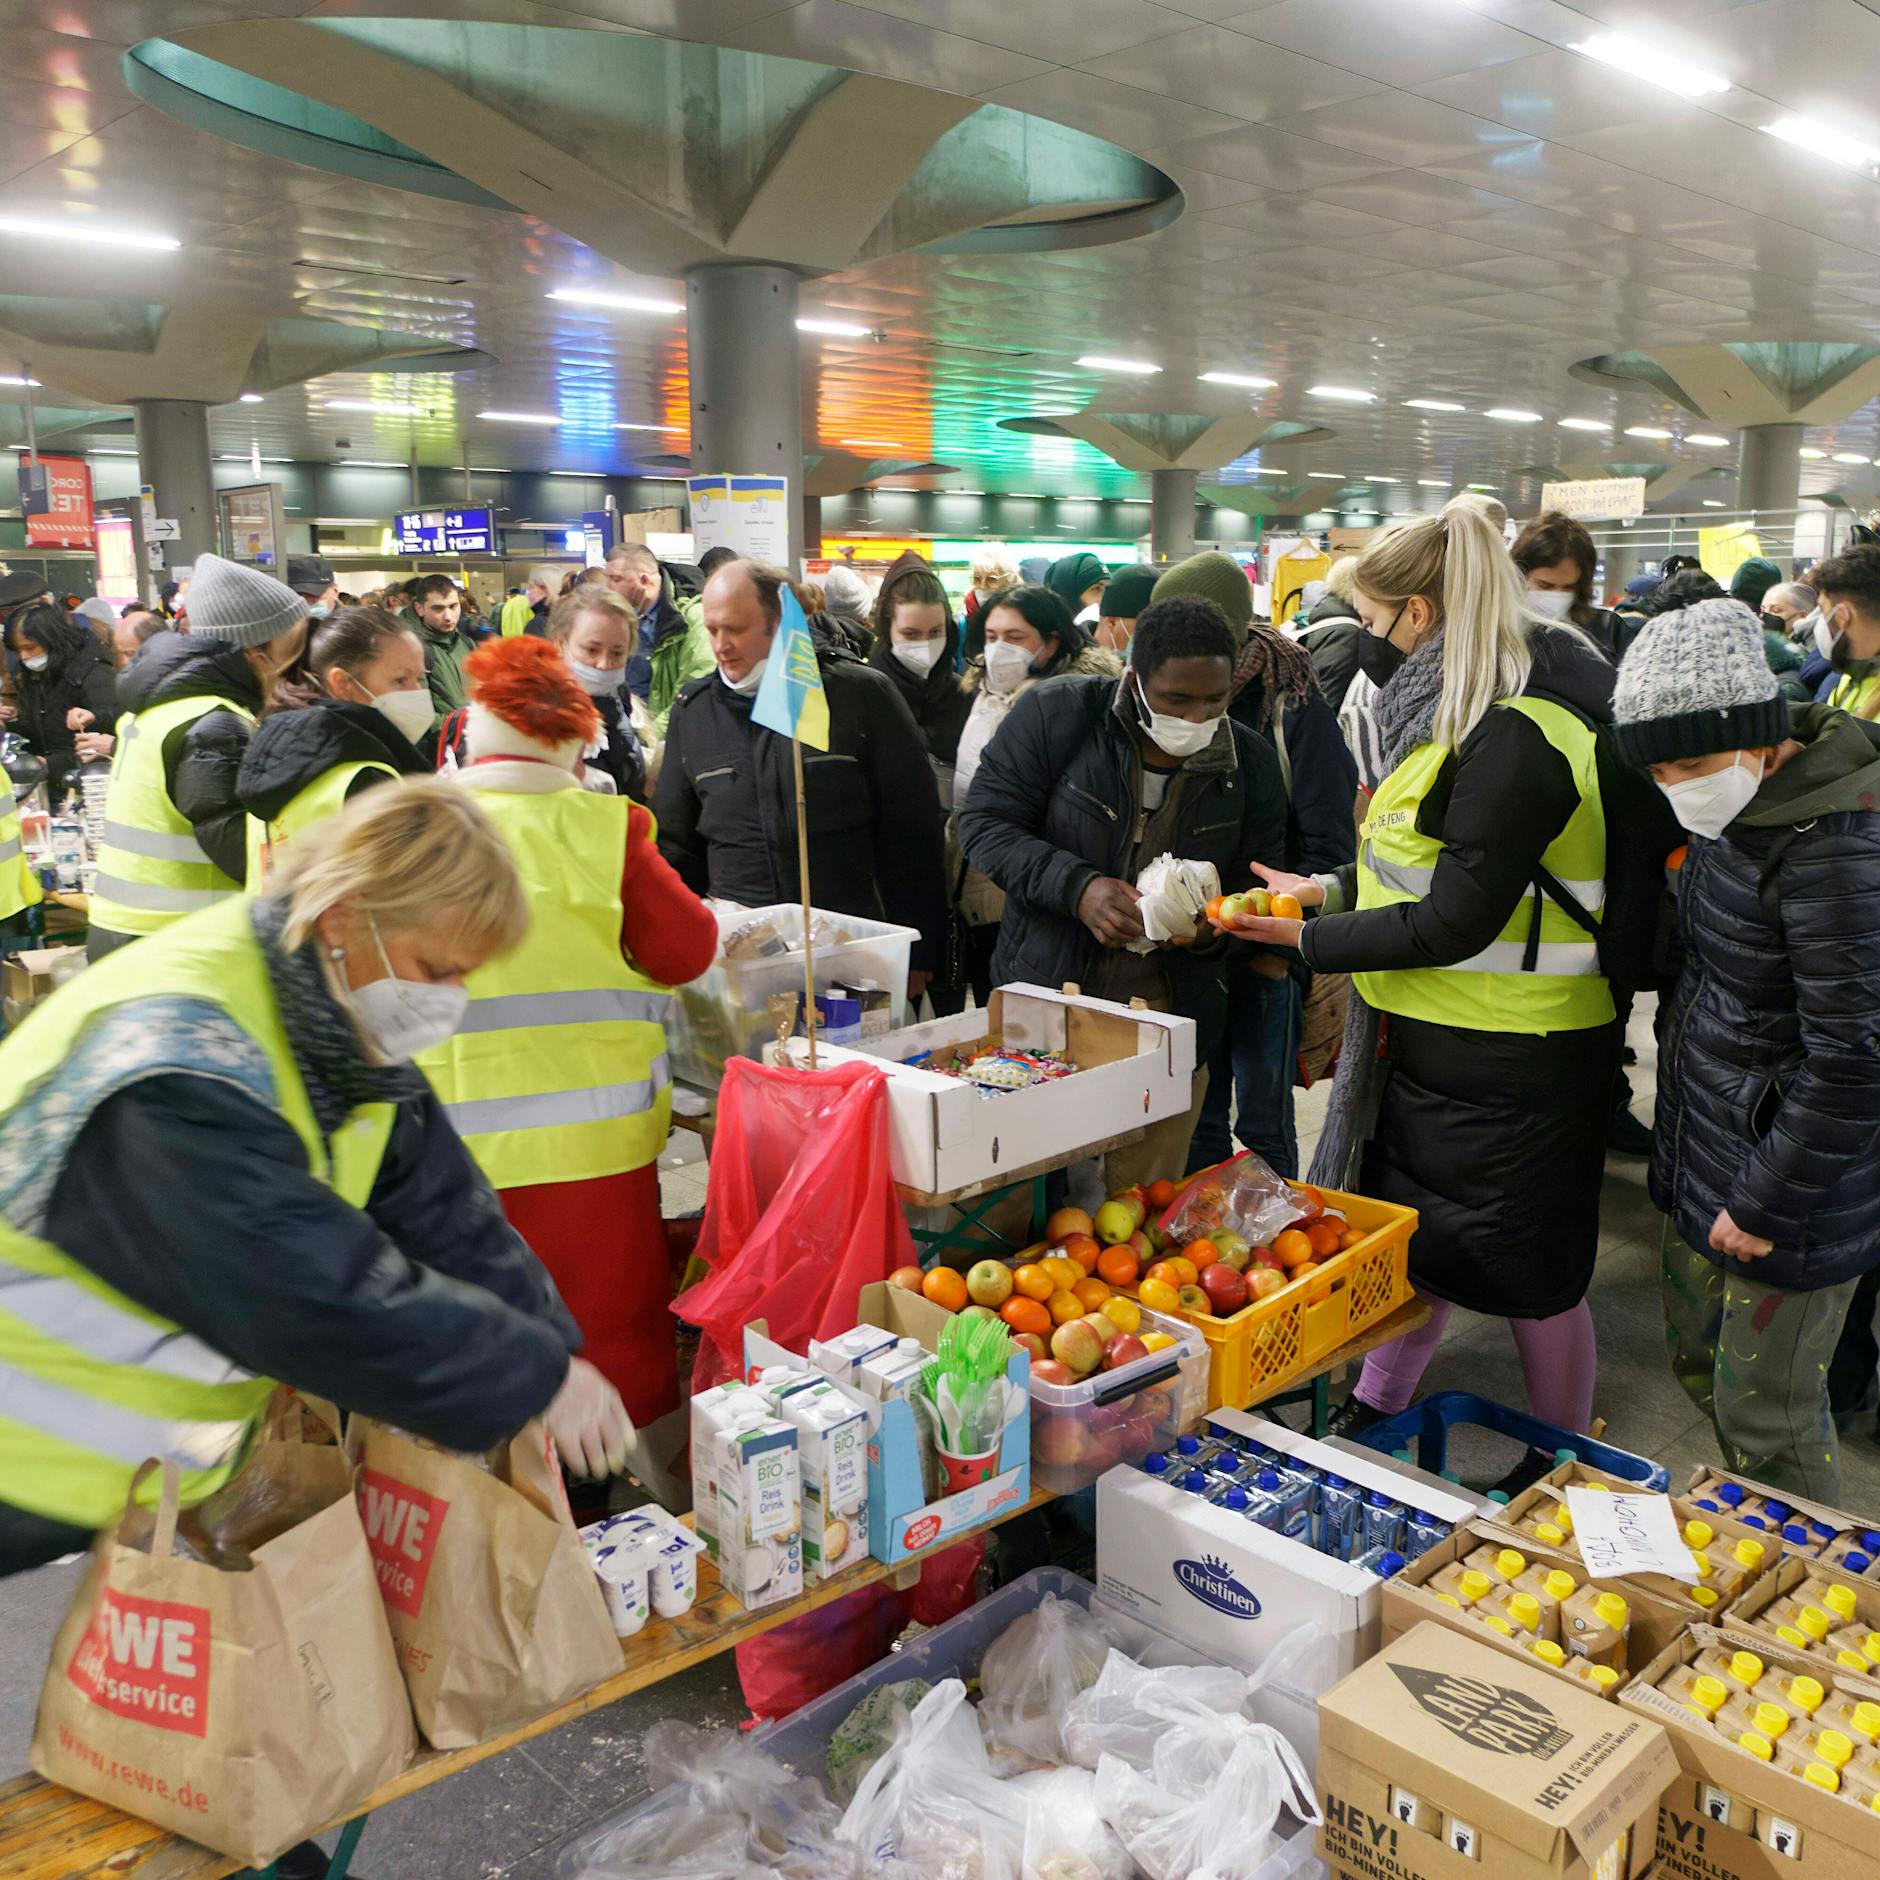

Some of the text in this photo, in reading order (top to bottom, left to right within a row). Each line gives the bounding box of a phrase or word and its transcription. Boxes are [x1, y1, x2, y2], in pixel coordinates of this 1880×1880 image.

[759, 1501, 785, 1514] Drink
[761, 1487, 782, 1499] Reis
[360, 1484, 430, 1562] WE
[1179, 1563, 1255, 1614] Christinen
[101, 1604, 196, 1679] WE
[1418, 1673, 1502, 1733] LAND
[1465, 1695, 1563, 1757] PARK
[59, 1724, 209, 1813] www.rewe.de
[1569, 1731, 1614, 1772] ICH BIN VOLLER
[1580, 1721, 1641, 1778] BIO-MINERALWASSER
[1534, 1770, 1583, 1811] HEY!
[1324, 1823, 1347, 1845] ICH
[1350, 1838, 1373, 1860] BIN
[1376, 1851, 1429, 1880] VOLLE
[1326, 1793, 1399, 1857] HEY!
[1656, 1836, 1677, 1855] IN
[1657, 1807, 1706, 1853] EY!
